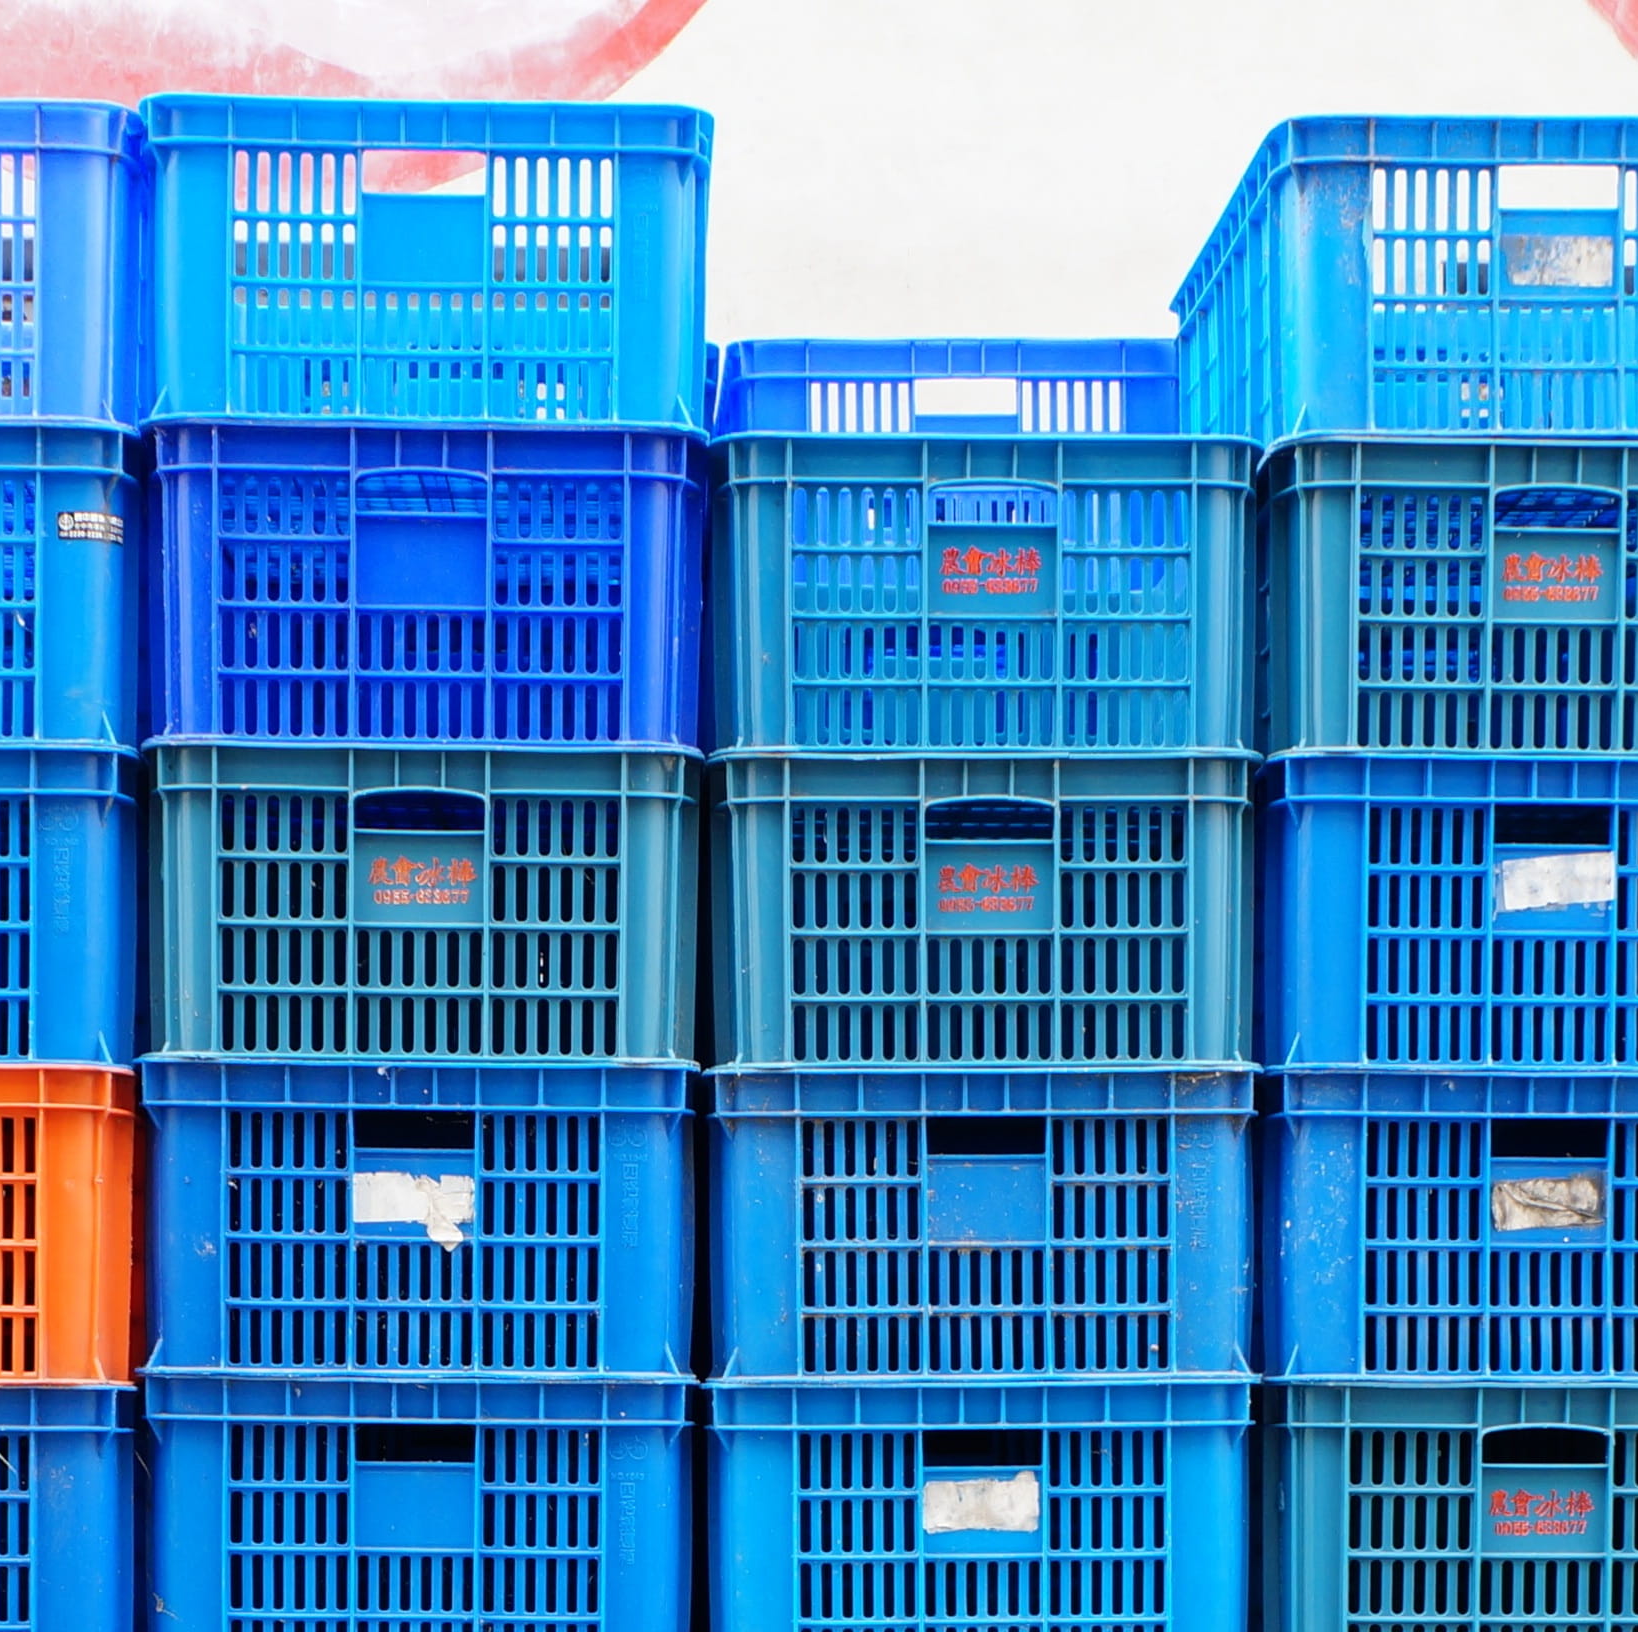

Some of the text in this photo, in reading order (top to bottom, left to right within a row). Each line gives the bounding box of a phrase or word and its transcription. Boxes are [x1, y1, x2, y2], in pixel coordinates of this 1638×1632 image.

[940, 546, 1041, 576] 農會冰棒
[1503, 552, 1603, 583] 農會冰棒
[368, 856, 476, 887] 農會冰棒
[938, 863, 1039, 894] 農會冰棒
[1490, 1489, 1595, 1518] 農會冰棒
